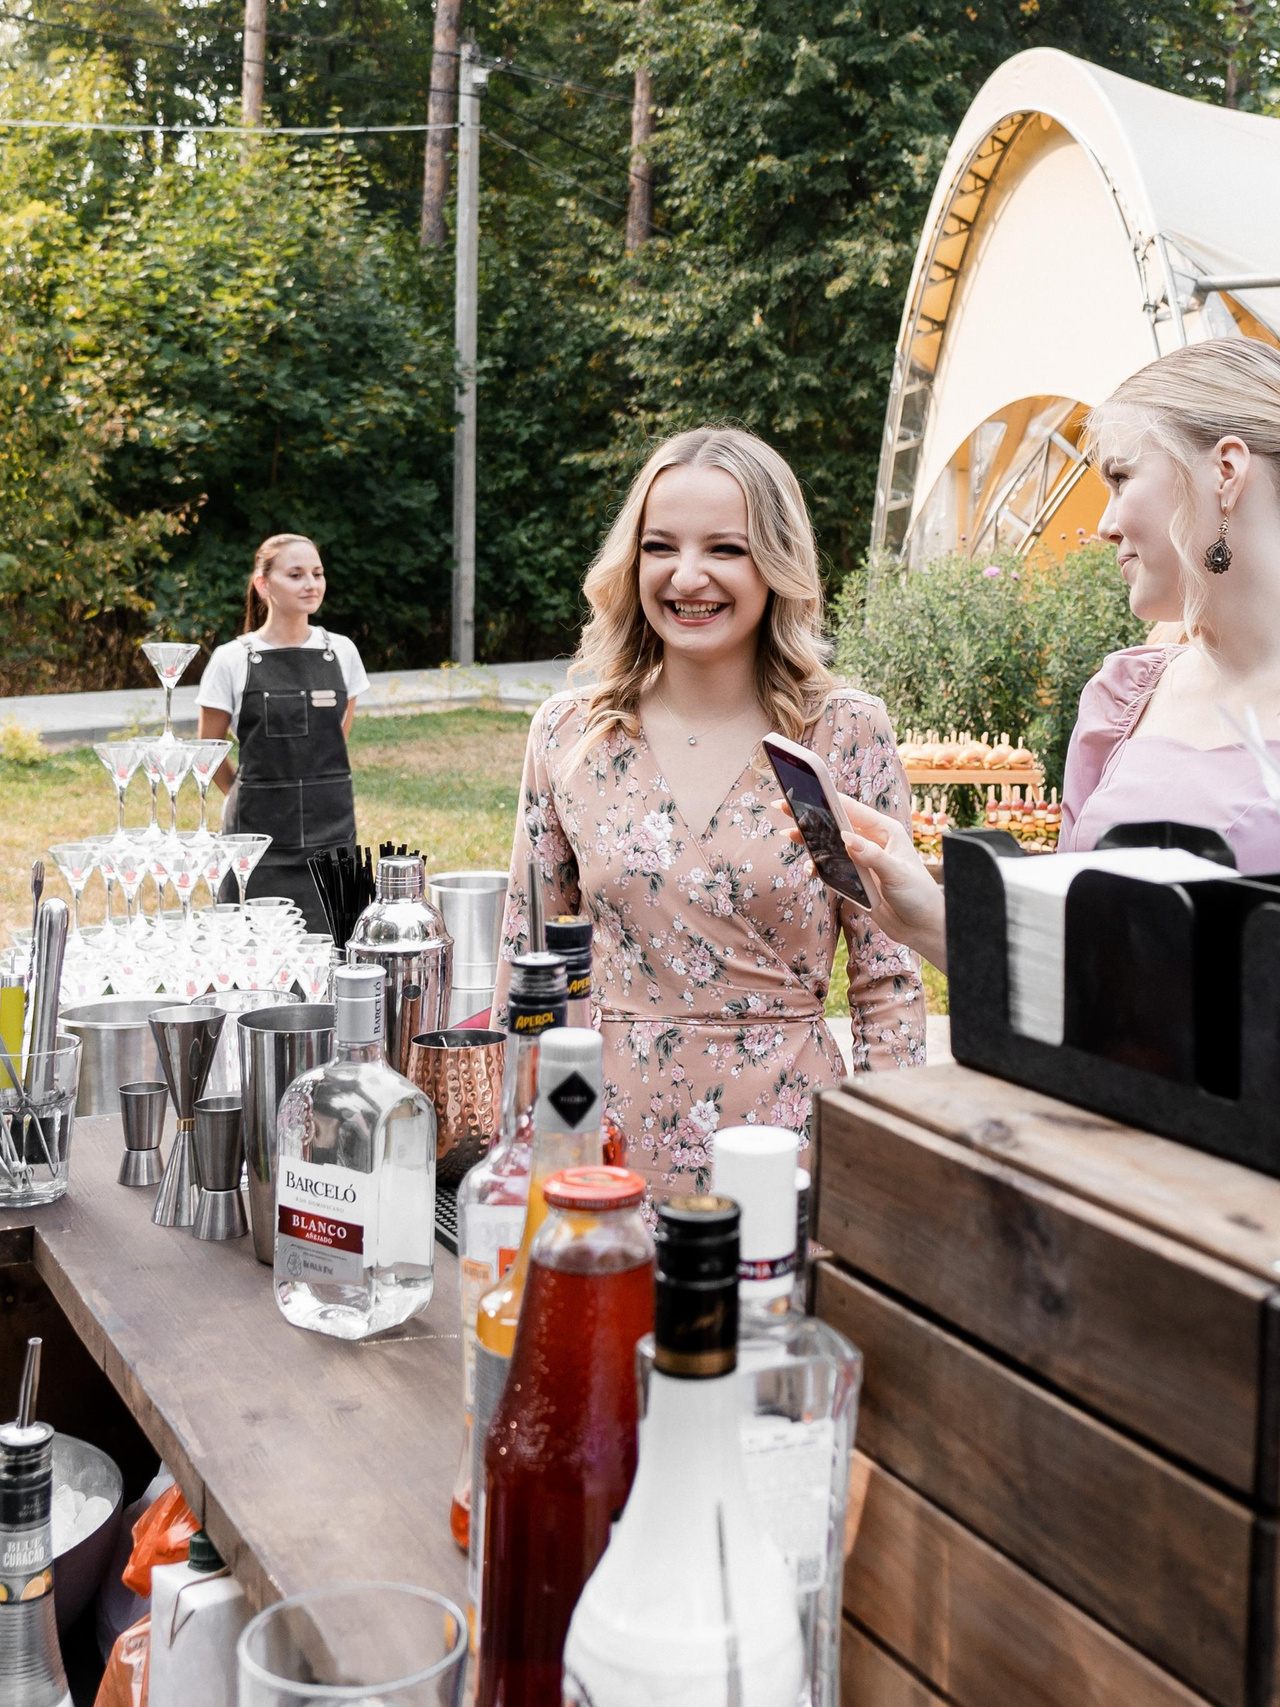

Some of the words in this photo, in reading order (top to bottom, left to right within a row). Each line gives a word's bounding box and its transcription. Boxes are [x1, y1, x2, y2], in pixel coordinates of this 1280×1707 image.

[515, 1012, 555, 1030] APEROL
[286, 1171, 356, 1203] BARCELÓ
[292, 1214, 347, 1239] BLANCO
[305, 1231, 333, 1245] AÑEJADO
